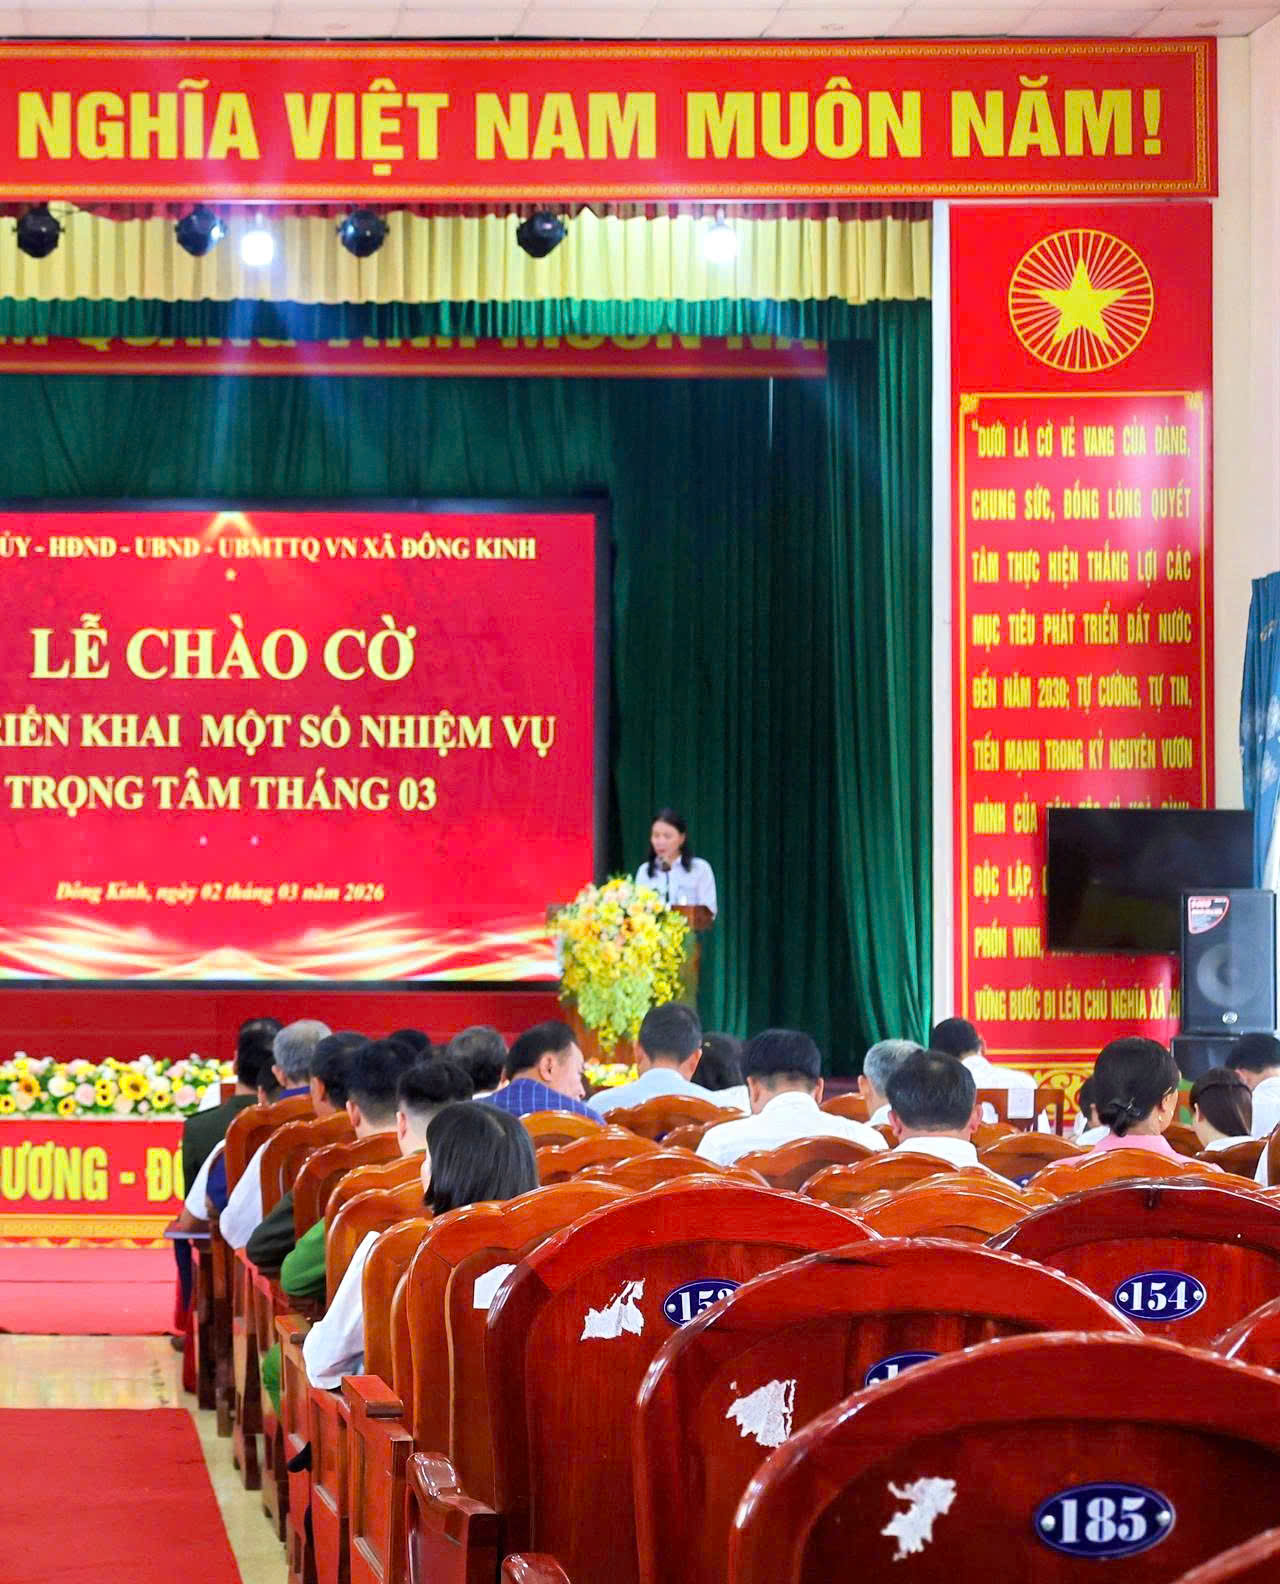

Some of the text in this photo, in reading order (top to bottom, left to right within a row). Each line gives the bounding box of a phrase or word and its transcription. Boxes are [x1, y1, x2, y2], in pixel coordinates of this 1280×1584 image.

[19, 79, 259, 159] NGHĨA
[285, 77, 449, 176] VIỆT
[475, 91, 657, 160] NAM
[686, 76, 921, 160] MUÔN
[951, 75, 1163, 158] NĂM!
[1084, 425, 1115, 457] VANG
[1123, 416, 1146, 457] CỦA
[972, 487, 1016, 520] CHUNG
[1108, 480, 1142, 519] LÒNG
[49, 536, 117, 558] HĐND
[135, 537, 200, 558] UBND
[219, 537, 320, 562] UBMTTQ
[326, 537, 357, 558] VN
[363, 532, 396, 559] XÃ
[401, 531, 470, 559] ĐÔNG
[475, 537, 536, 559] KINH
[972, 545, 1000, 582] TÂM
[1008, 548, 1040, 590] THỰC
[1048, 544, 1079, 589] HIỆN
[1137, 548, 1157, 588] LỢI
[1167, 544, 1192, 582] CÁC
[29, 613, 416, 681] LỄ CHÀO CỜ
[972, 613, 1001, 653] MỤC
[1008, 608, 1036, 645] TIÊU
[1043, 608, 1075, 645] PHÁT
[1159, 605, 1192, 644] NƯỚC
[80, 714, 181, 747] KHAI
[200, 708, 292, 757] MỘT
[300, 705, 351, 748] SỐ
[360, 709, 492, 757] NHIỆM
[501, 715, 556, 758] VỤ
[1005, 739, 1040, 779] MẠNH
[1045, 739, 1084, 771] TRONG
[1109, 733, 1156, 770] NGUYÊN
[4, 767, 437, 818] TRỌNG TÂM THÁNG 03
[1013, 792, 1037, 834] CỦA
[155, 882, 197, 905] ngày
[200, 882, 221, 901] 02
[225, 882, 273, 905] tháng
[277, 883, 298, 901] 03
[302, 882, 340, 901] năm
[343, 883, 385, 901] 2026
[973, 859, 1000, 904] ĐỘC
[1084, 979, 1108, 1020] CHỦ
[1111, 983, 1147, 1019] NGHĨA
[1130, 1281, 1188, 1311] 154
[1058, 1495, 1147, 1544] 185
